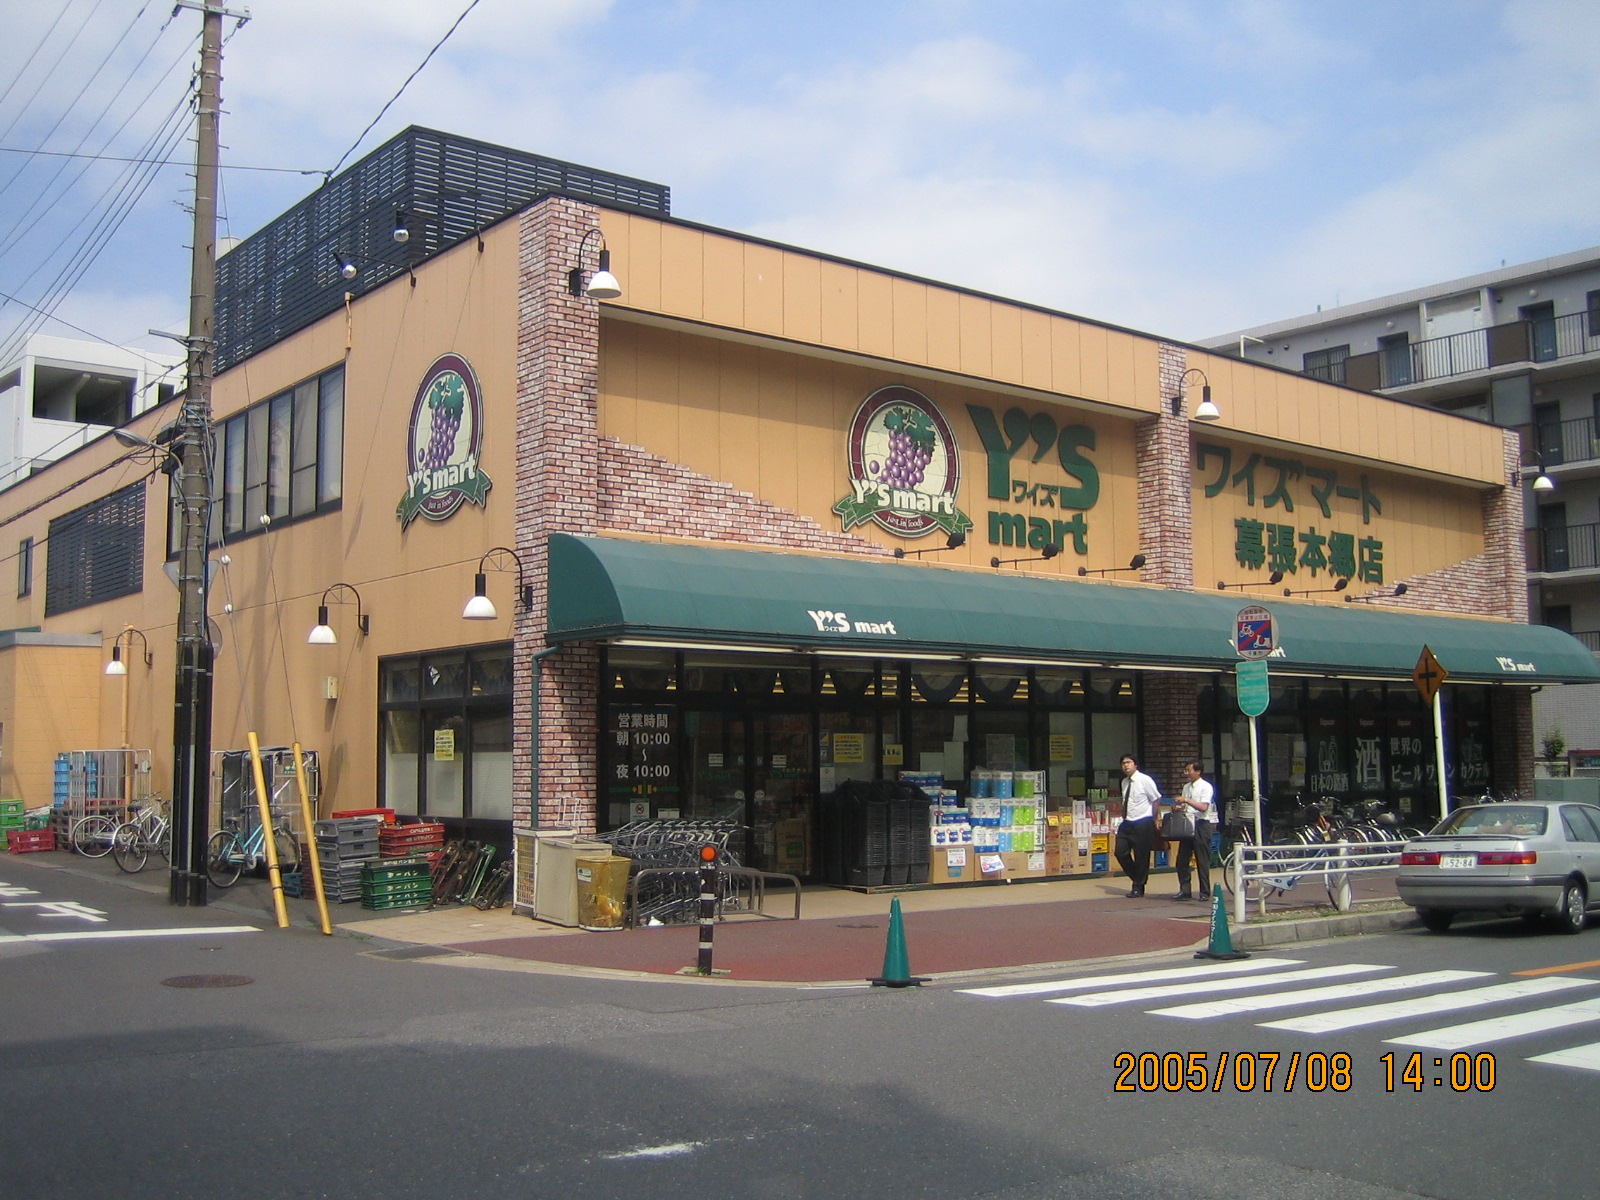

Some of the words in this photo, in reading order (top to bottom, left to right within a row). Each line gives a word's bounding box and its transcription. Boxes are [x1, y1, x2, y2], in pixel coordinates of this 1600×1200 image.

[432, 452, 476, 491] mart
[1196, 441, 1382, 525] ワイズマート
[892, 487, 955, 515] mart
[1012, 479, 1060, 507] ワイズ
[987, 510, 1088, 554] mart
[1234, 517, 1384, 585] 幕張本郷店
[853, 620, 897, 635] mart
[1517, 662, 1536, 672] mart
[618, 713, 669, 729] 営業時間
[616, 732, 630, 746] 朝
[634, 732, 671, 746] 10:00
[1390, 737, 1422, 755] 世界の
[1355, 736, 1381, 783] 酒
[616, 764, 629, 779] 夜
[634, 764, 671, 778] 10:00
[1391, 764, 1422, 783] ビール
[1426, 764, 1455, 779] ワン
